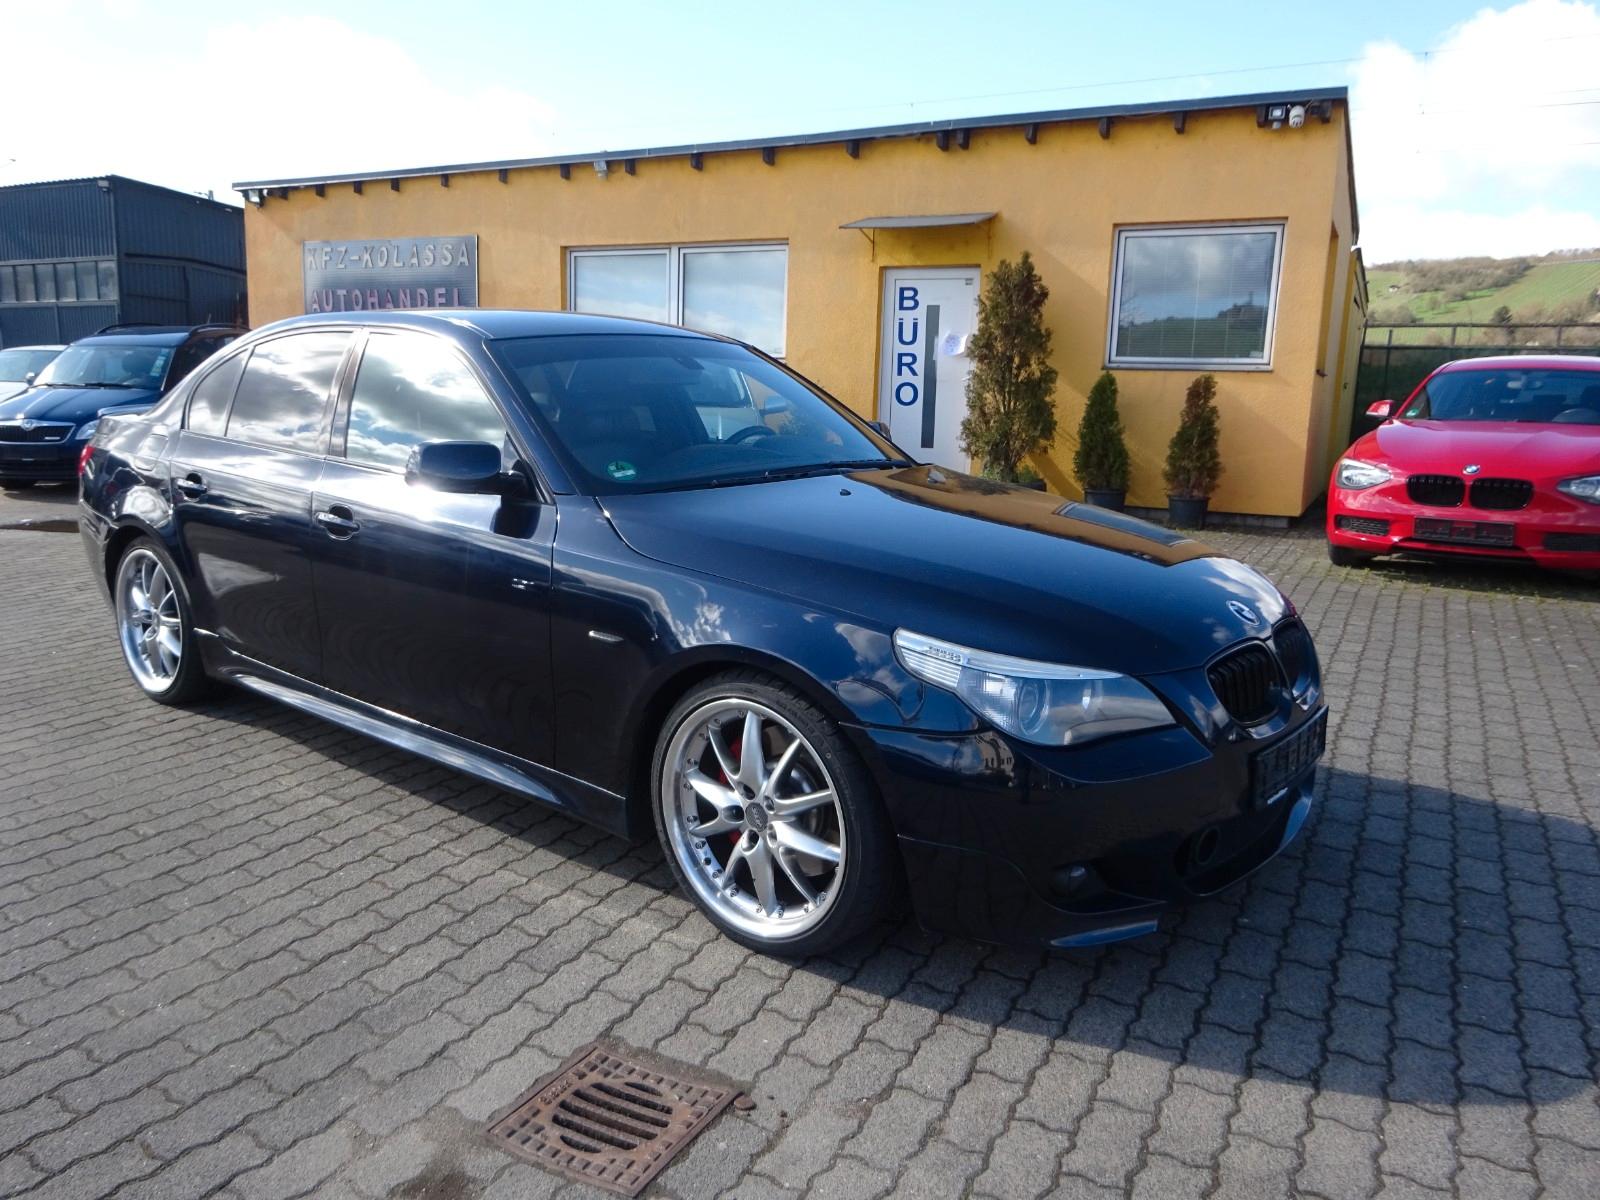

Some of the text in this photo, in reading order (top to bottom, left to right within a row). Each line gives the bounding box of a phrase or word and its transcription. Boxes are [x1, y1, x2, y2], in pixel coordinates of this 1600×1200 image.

[306, 243, 470, 270] KFZ-KOLASSA
[311, 287, 465, 312] AUTOHANDEL
[895, 286, 919, 407] BÜRO
